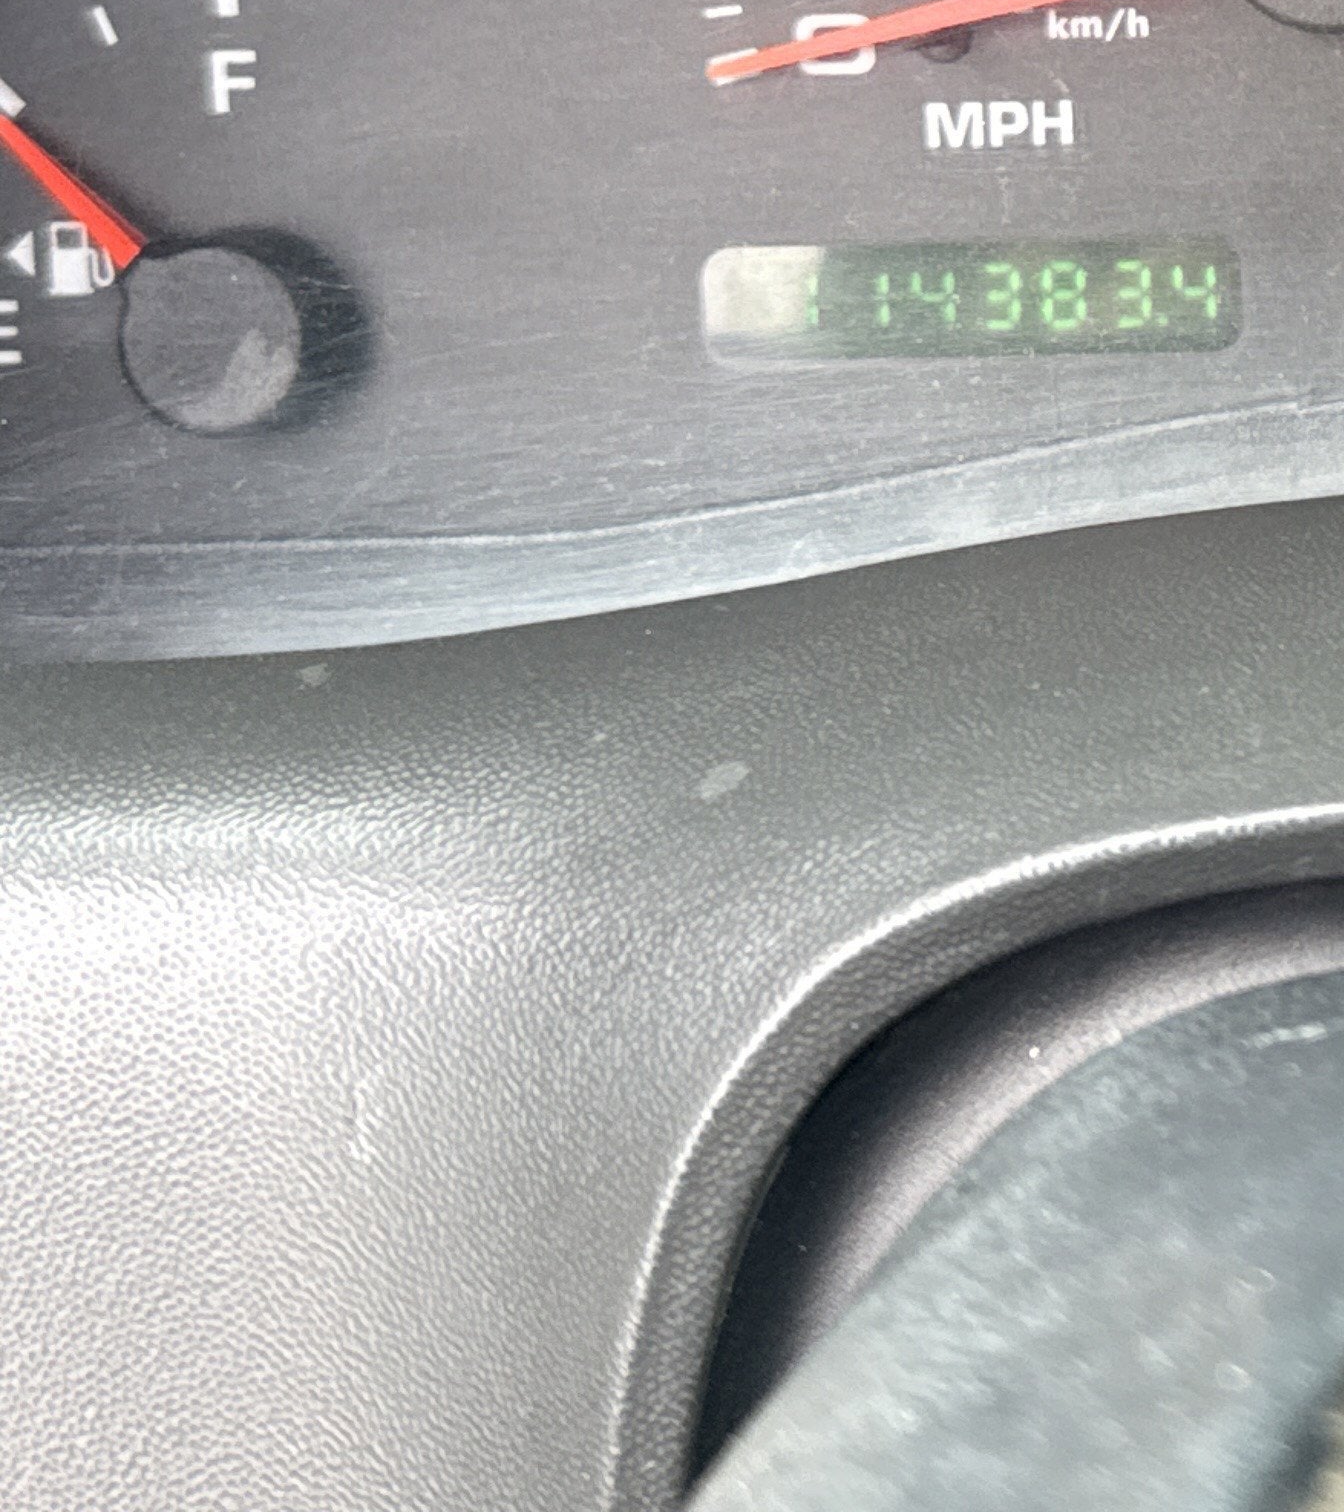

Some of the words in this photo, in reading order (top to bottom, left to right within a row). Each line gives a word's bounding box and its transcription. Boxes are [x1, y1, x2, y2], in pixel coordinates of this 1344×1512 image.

[793, 13, 876, 75] 0
[1046, 7, 1150, 42] km/h
[208, 49, 257, 114] F
[923, 99, 1074, 150] MPH
